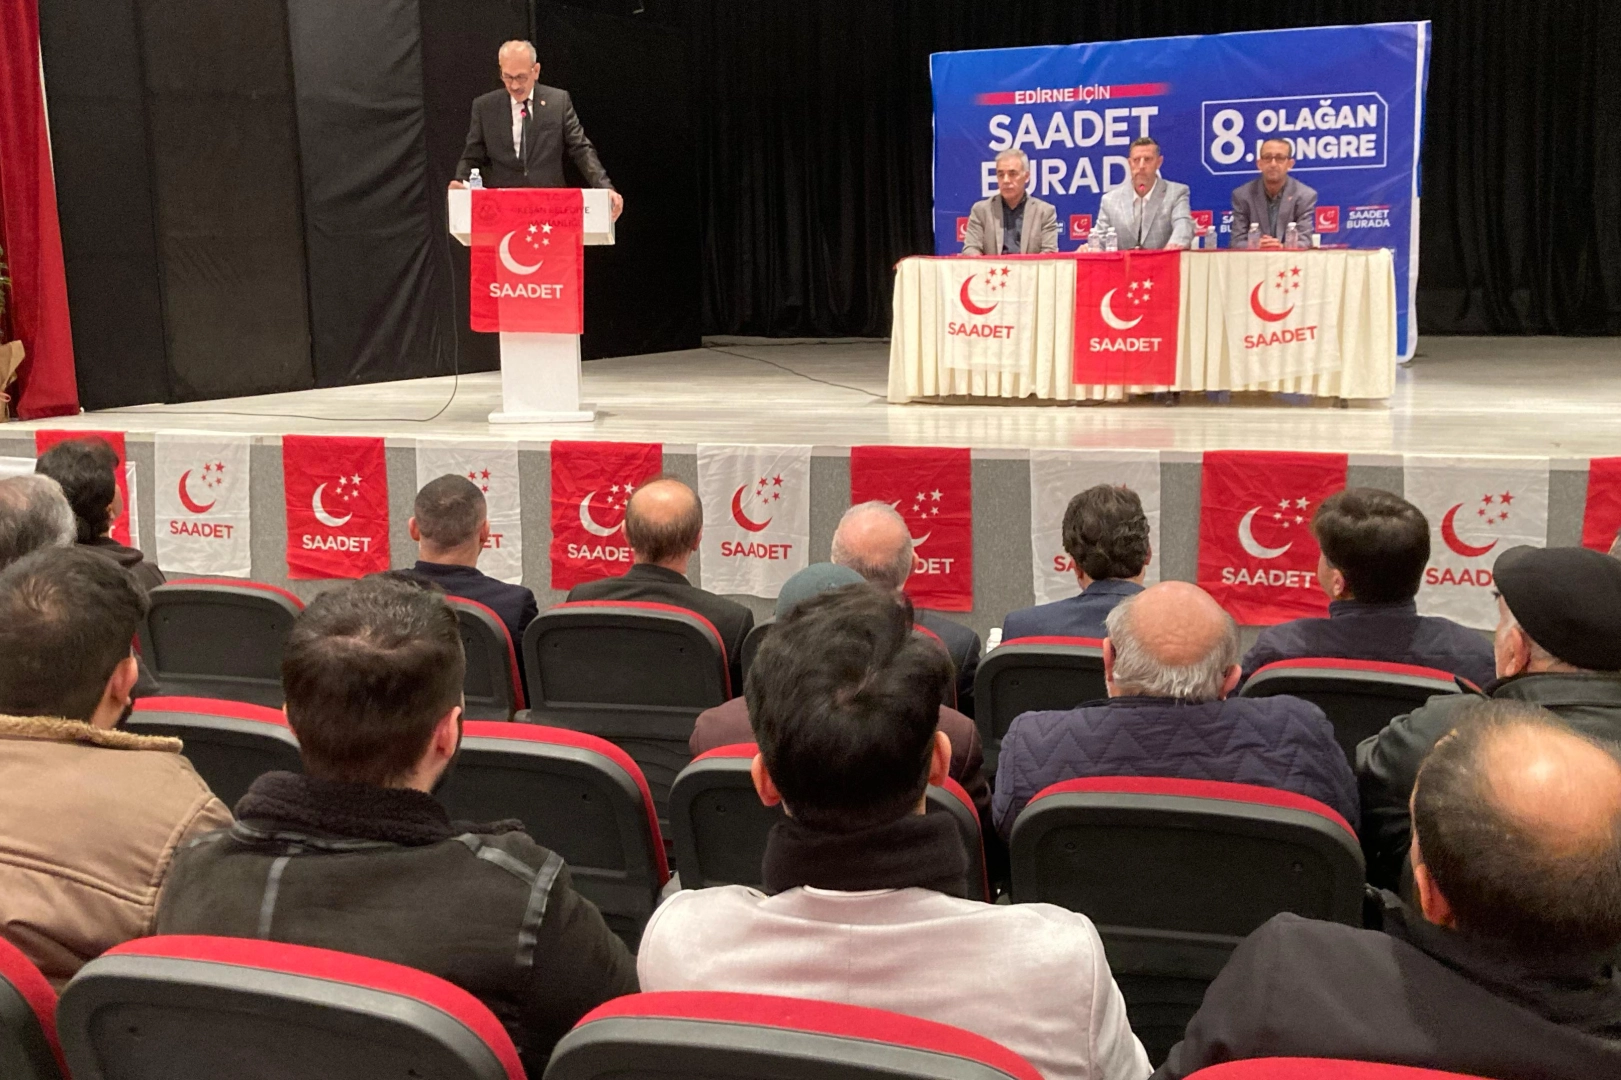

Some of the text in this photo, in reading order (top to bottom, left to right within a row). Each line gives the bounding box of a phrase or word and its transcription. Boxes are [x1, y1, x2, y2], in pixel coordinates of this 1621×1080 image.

[1014, 84, 1111, 105] EDİRNE İÇİN
[1256, 99, 1378, 133] OLAĞAN
[988, 106, 1159, 152] SAADET
[1211, 109, 1254, 164] 8.
[1346, 219, 1391, 229] BURADA
[1348, 209, 1390, 220] SAADET
[489, 283, 564, 299] SAADET
[948, 322, 1014, 339] SAADET
[1244, 326, 1317, 349] SAADET
[1089, 337, 1162, 352] SAADET
[170, 520, 233, 539] SAADET
[302, 534, 371, 552] SAADET
[567, 543, 635, 562] SAADE
[721, 541, 792, 560] SAADET
[1222, 567, 1316, 589] SAADET
